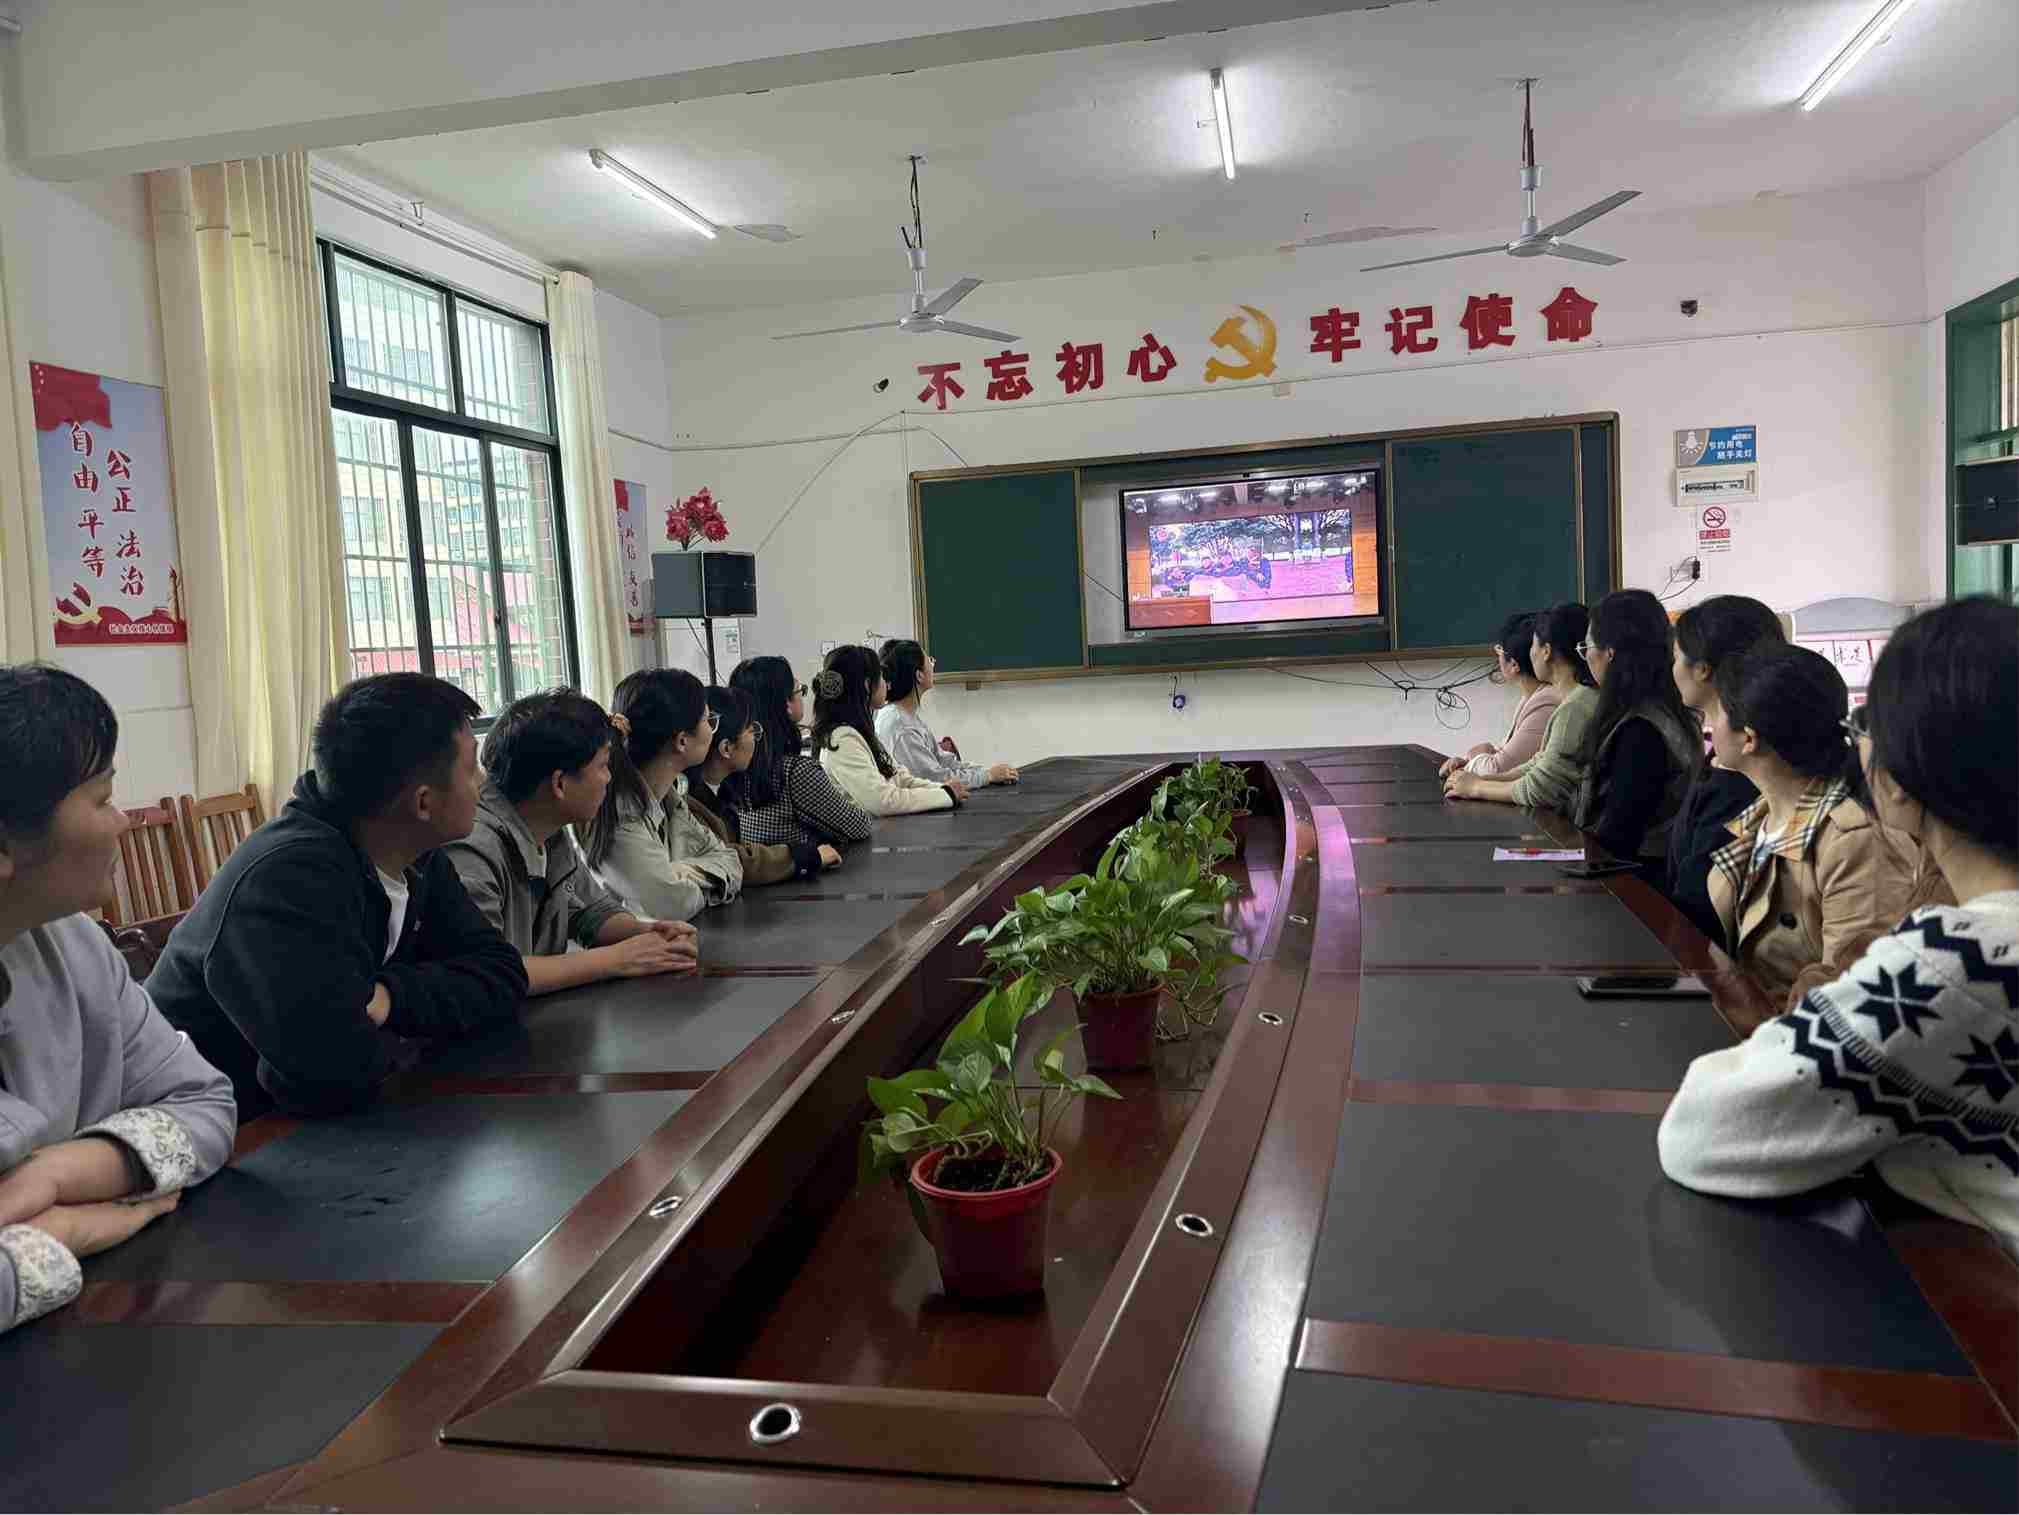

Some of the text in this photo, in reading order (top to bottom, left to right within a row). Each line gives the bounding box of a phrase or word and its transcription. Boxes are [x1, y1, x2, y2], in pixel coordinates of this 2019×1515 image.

[917, 286, 1599, 411] 不忘初心 牢记使命
[71, 424, 105, 578] 自由平等
[106, 448, 144, 597] 公正法治
